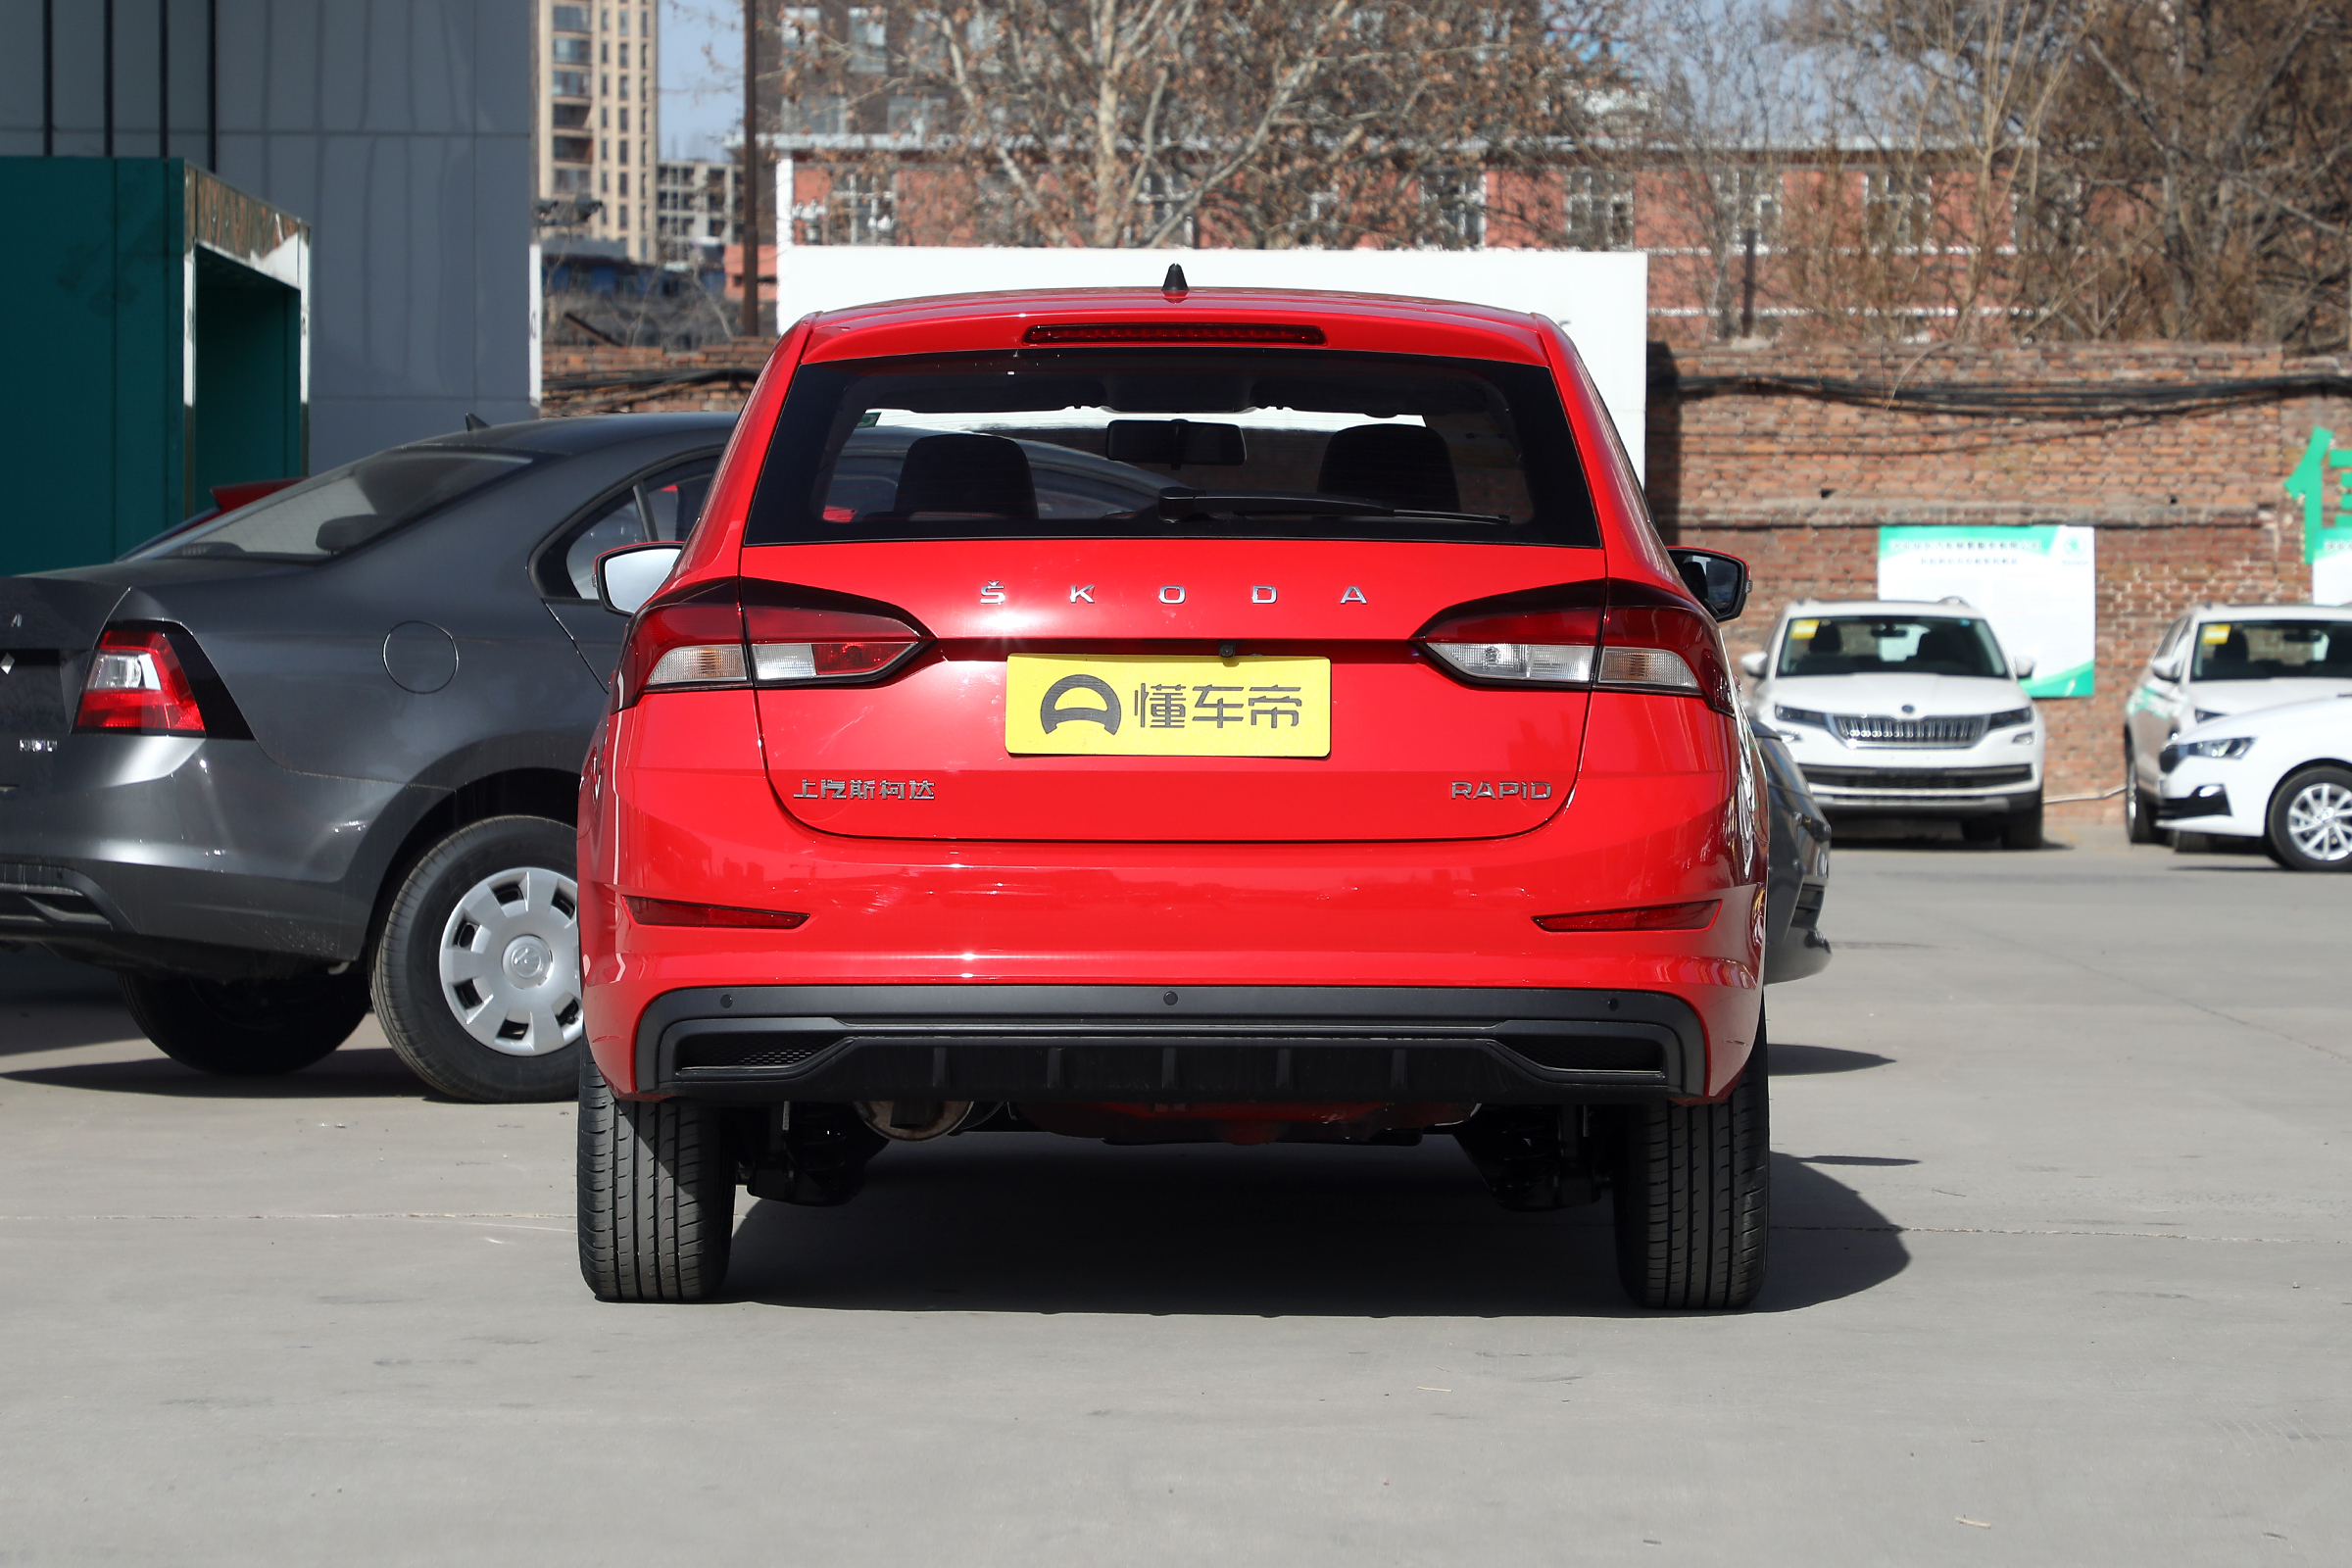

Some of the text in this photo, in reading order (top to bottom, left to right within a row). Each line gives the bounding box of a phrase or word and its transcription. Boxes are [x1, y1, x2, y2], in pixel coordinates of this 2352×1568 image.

[980, 580, 1367, 604] ŠKODA
[1134, 682, 1302, 728] 懂车帝
[793, 779, 935, 800] 上汽斯柯达
[1451, 782, 1551, 799] RAPID
